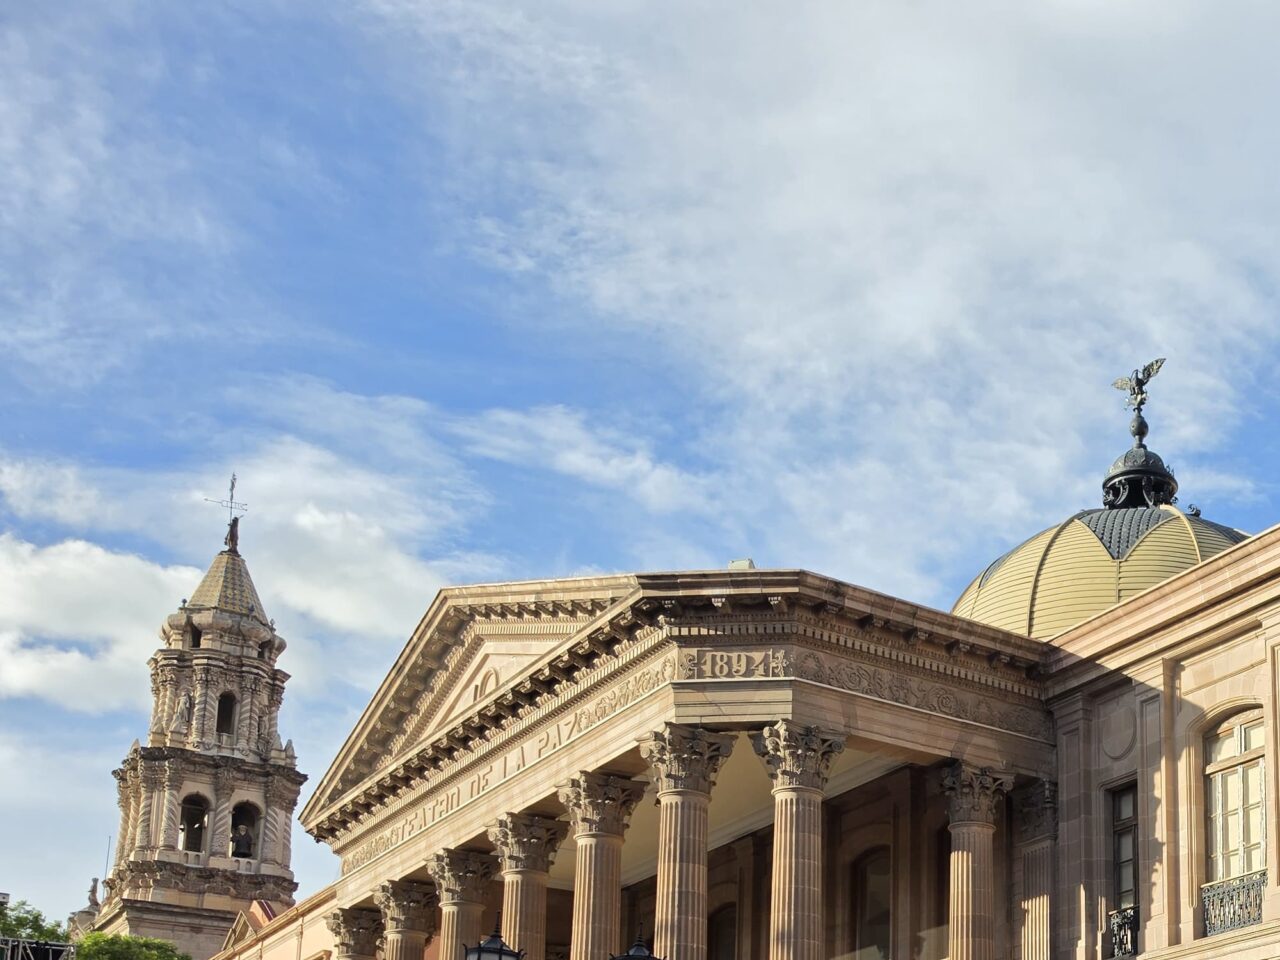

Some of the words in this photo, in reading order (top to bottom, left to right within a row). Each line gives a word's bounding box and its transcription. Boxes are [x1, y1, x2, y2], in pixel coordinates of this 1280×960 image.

[701, 651, 767, 677] 1894
[468, 764, 494, 799] DE
[536, 712, 579, 760] PAZ
